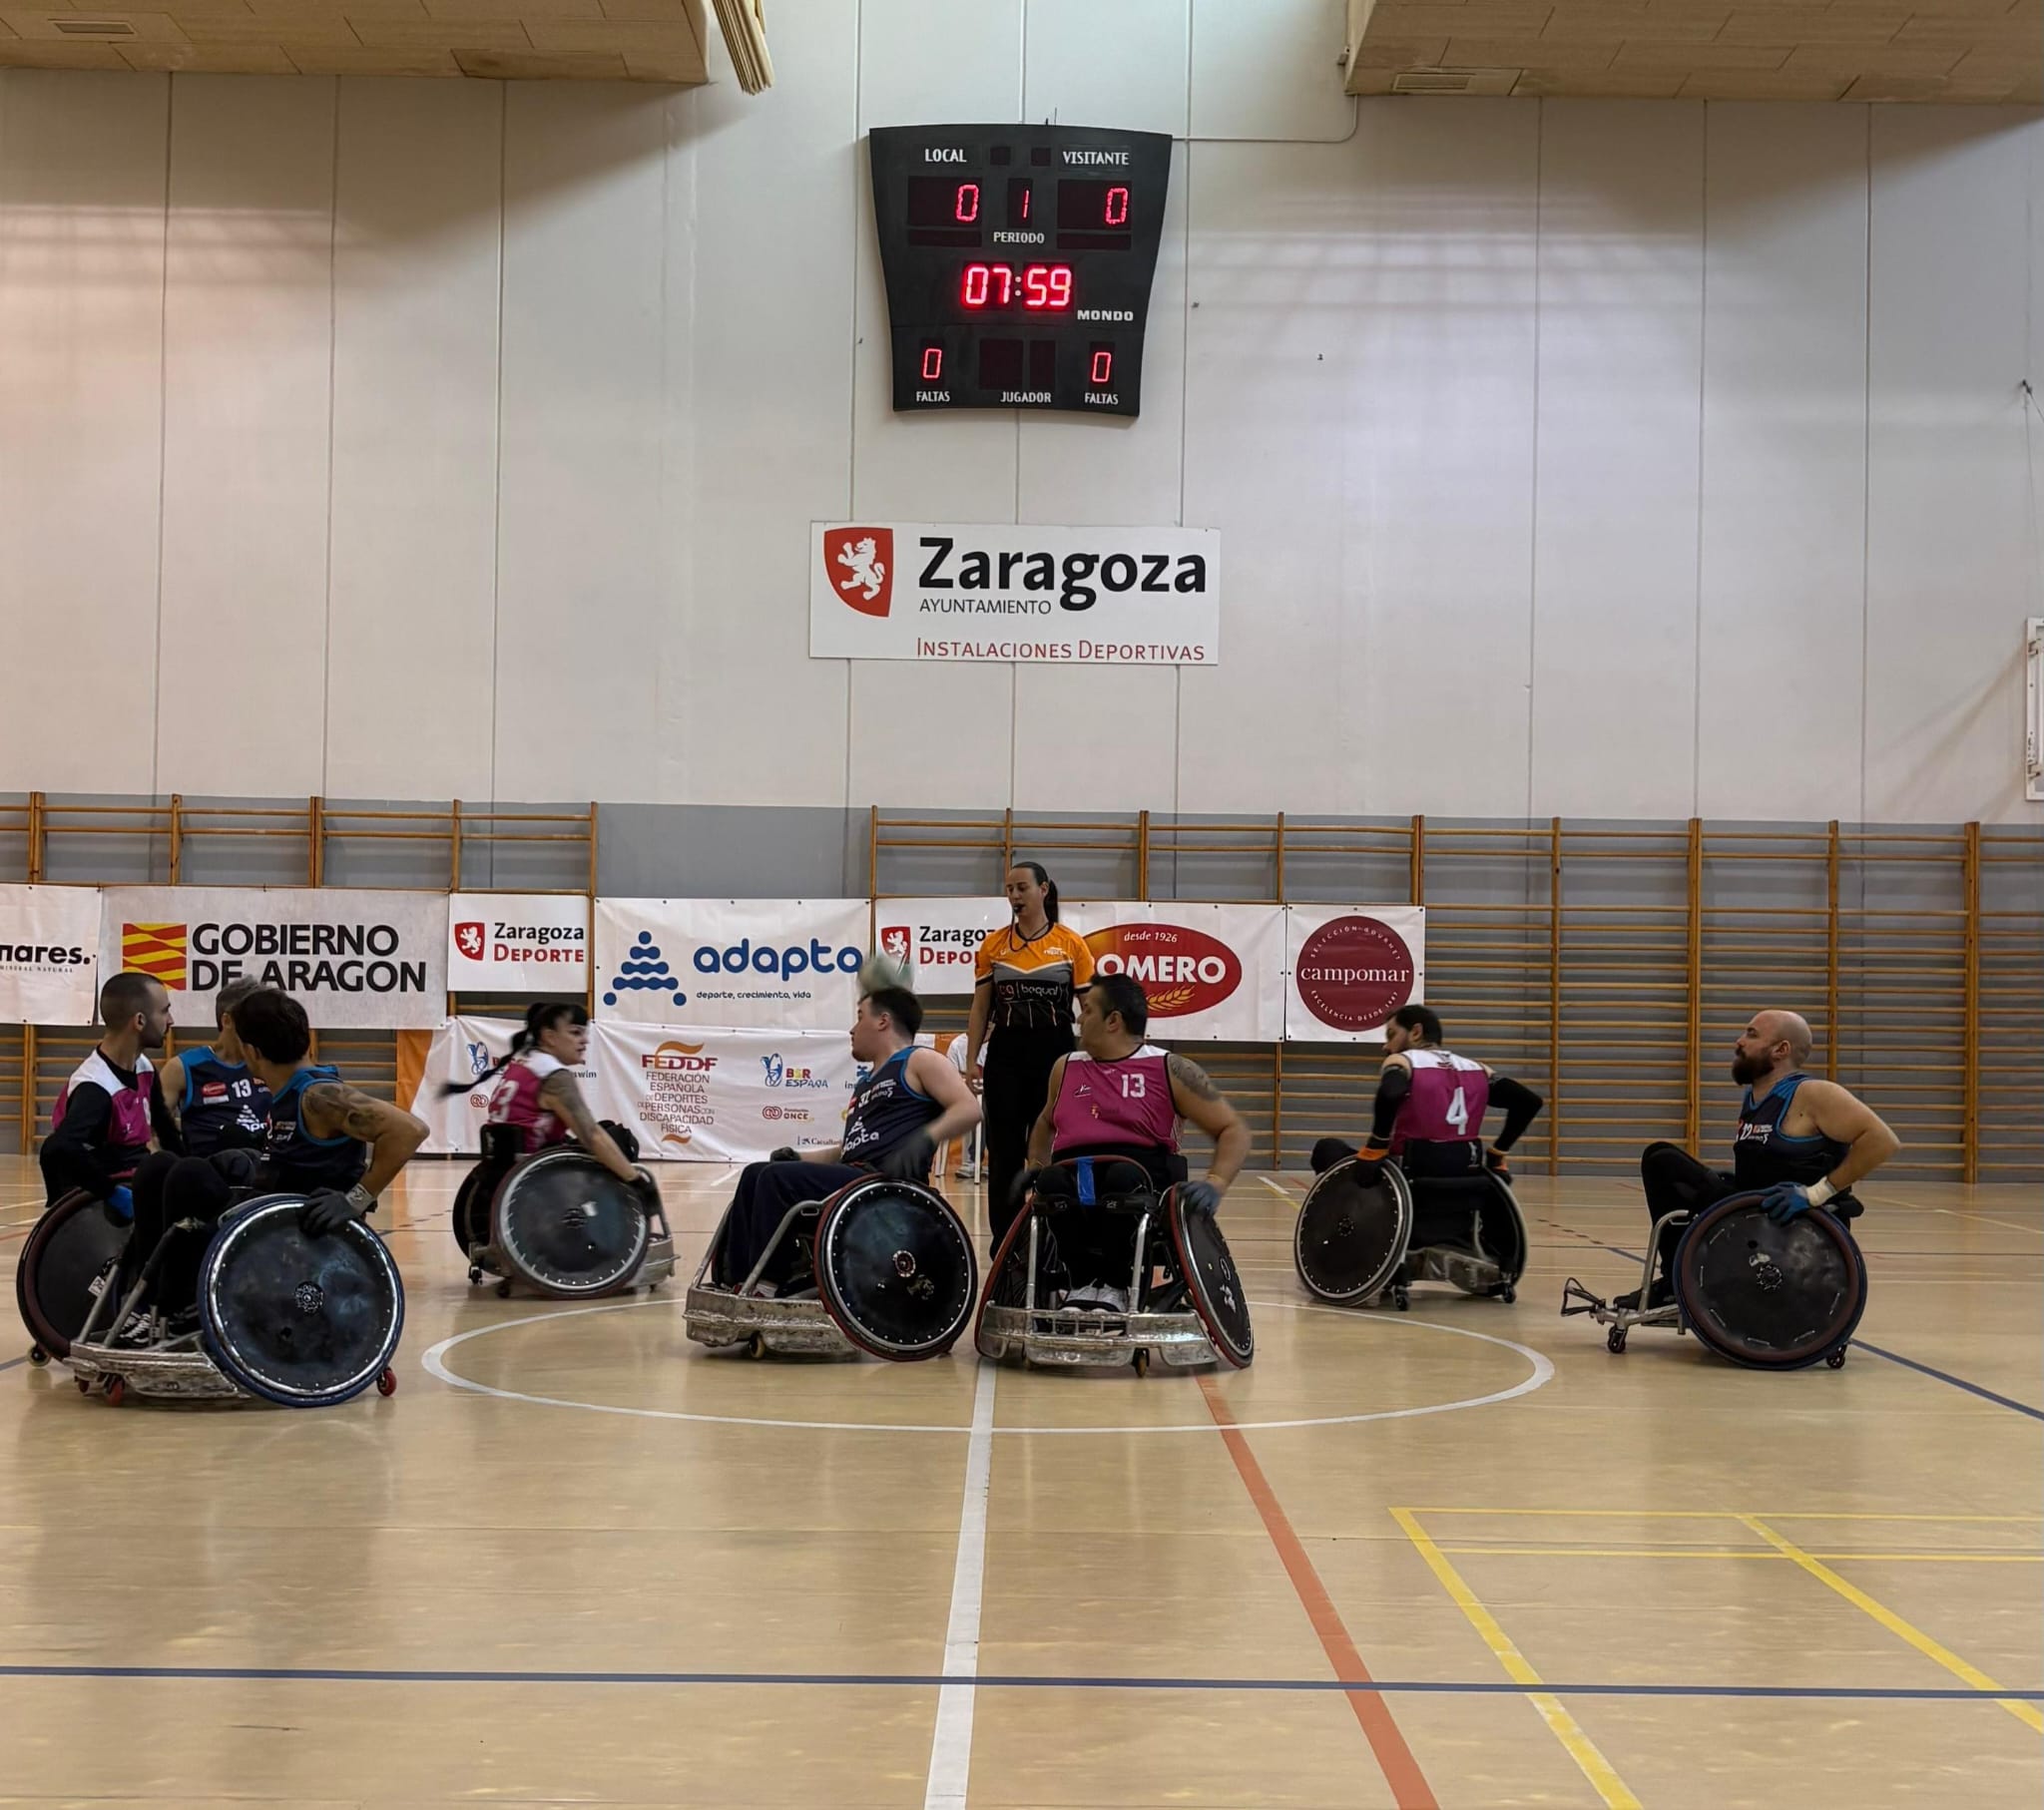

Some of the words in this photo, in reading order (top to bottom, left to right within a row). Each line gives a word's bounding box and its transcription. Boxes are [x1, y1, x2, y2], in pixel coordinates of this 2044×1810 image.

[924, 148, 967, 164] LOCAL
[1063, 151, 1130, 166] VISITANTE
[956, 184, 980, 223] 0
[1022, 190, 1030, 219] 1
[1104, 187, 1129, 225] 0
[993, 231, 1045, 244] PERIODO
[964, 265, 1073, 307] 07:59
[1077, 309, 1135, 322] MONDO
[921, 348, 943, 380] 0
[1090, 351, 1112, 383] 0
[915, 390, 951, 403] FALTAS
[1000, 391, 1052, 404] JUGADOR
[1084, 392, 1119, 406] FALTAS
[918, 536, 1208, 612] Zaragoza
[918, 598, 1053, 616] AYUNTAMIENTO
[916, 637, 1072, 660] INSTALACIONES
[1079, 640, 1206, 662] DEPORTIVAS
[192, 922, 400, 957] GOBIERNO
[494, 922, 585, 945] Zaragoza
[919, 926, 996, 948] Zarago
[1124, 930, 1152, 942] desde
[1154, 931, 1179, 944] 1926
[493, 942, 585, 963] DEPORTE
[192, 959, 243, 992] DE
[261, 959, 427, 993] ARAGON
[1300, 966, 1410, 986] campomar
[696, 990, 736, 1001] deporte,
[737, 991, 791, 1000] crecimiento,
[792, 990, 811, 999] vida
[641, 1054, 719, 1072] FEDDF
[646, 1071, 711, 1084] FEDERACIÓN
[1121, 1073, 1146, 1099] 13
[231, 1078, 253, 1099] 13
[650, 1082, 706, 1094] ESPAÑOLA
[655, 1092, 709, 1105] DEPORTES
[639, 1112, 715, 1126] DISCAPACIDAD
[1445, 1086, 1469, 1135] 4
